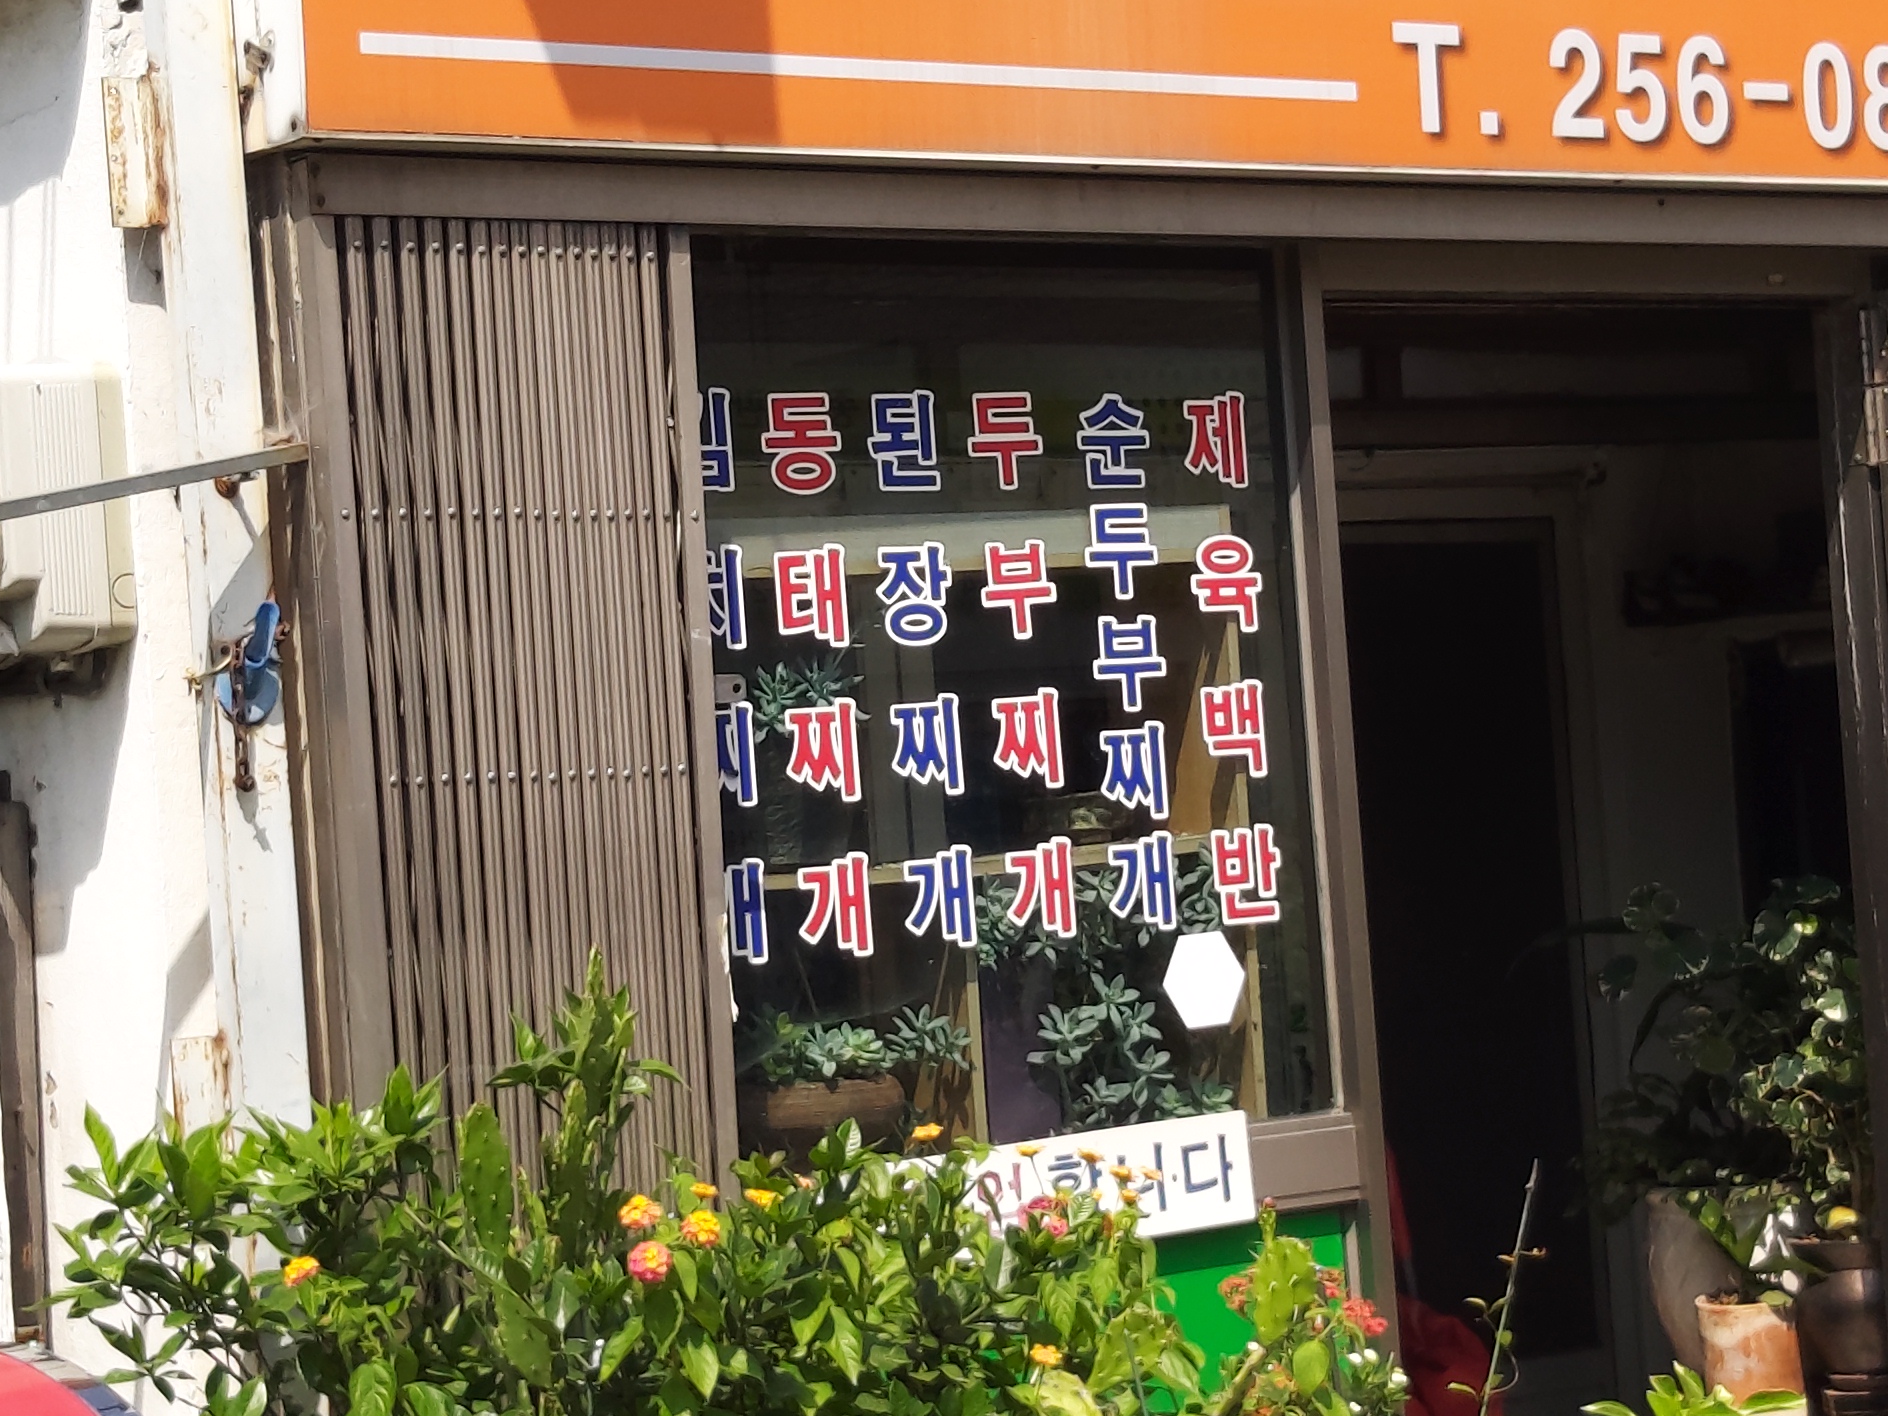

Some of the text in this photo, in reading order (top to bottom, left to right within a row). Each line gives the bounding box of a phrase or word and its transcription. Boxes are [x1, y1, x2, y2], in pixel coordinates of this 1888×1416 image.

[1392, 20, 1501, 136] T.
[762, 392, 873, 957] 동태찌개
[867, 388, 977, 946] 된장찌개
[968, 390, 1076, 937] 두부찌개
[1076, 392, 1174, 930] 순두부찌개
[1184, 390, 1280, 925] 제육백반
